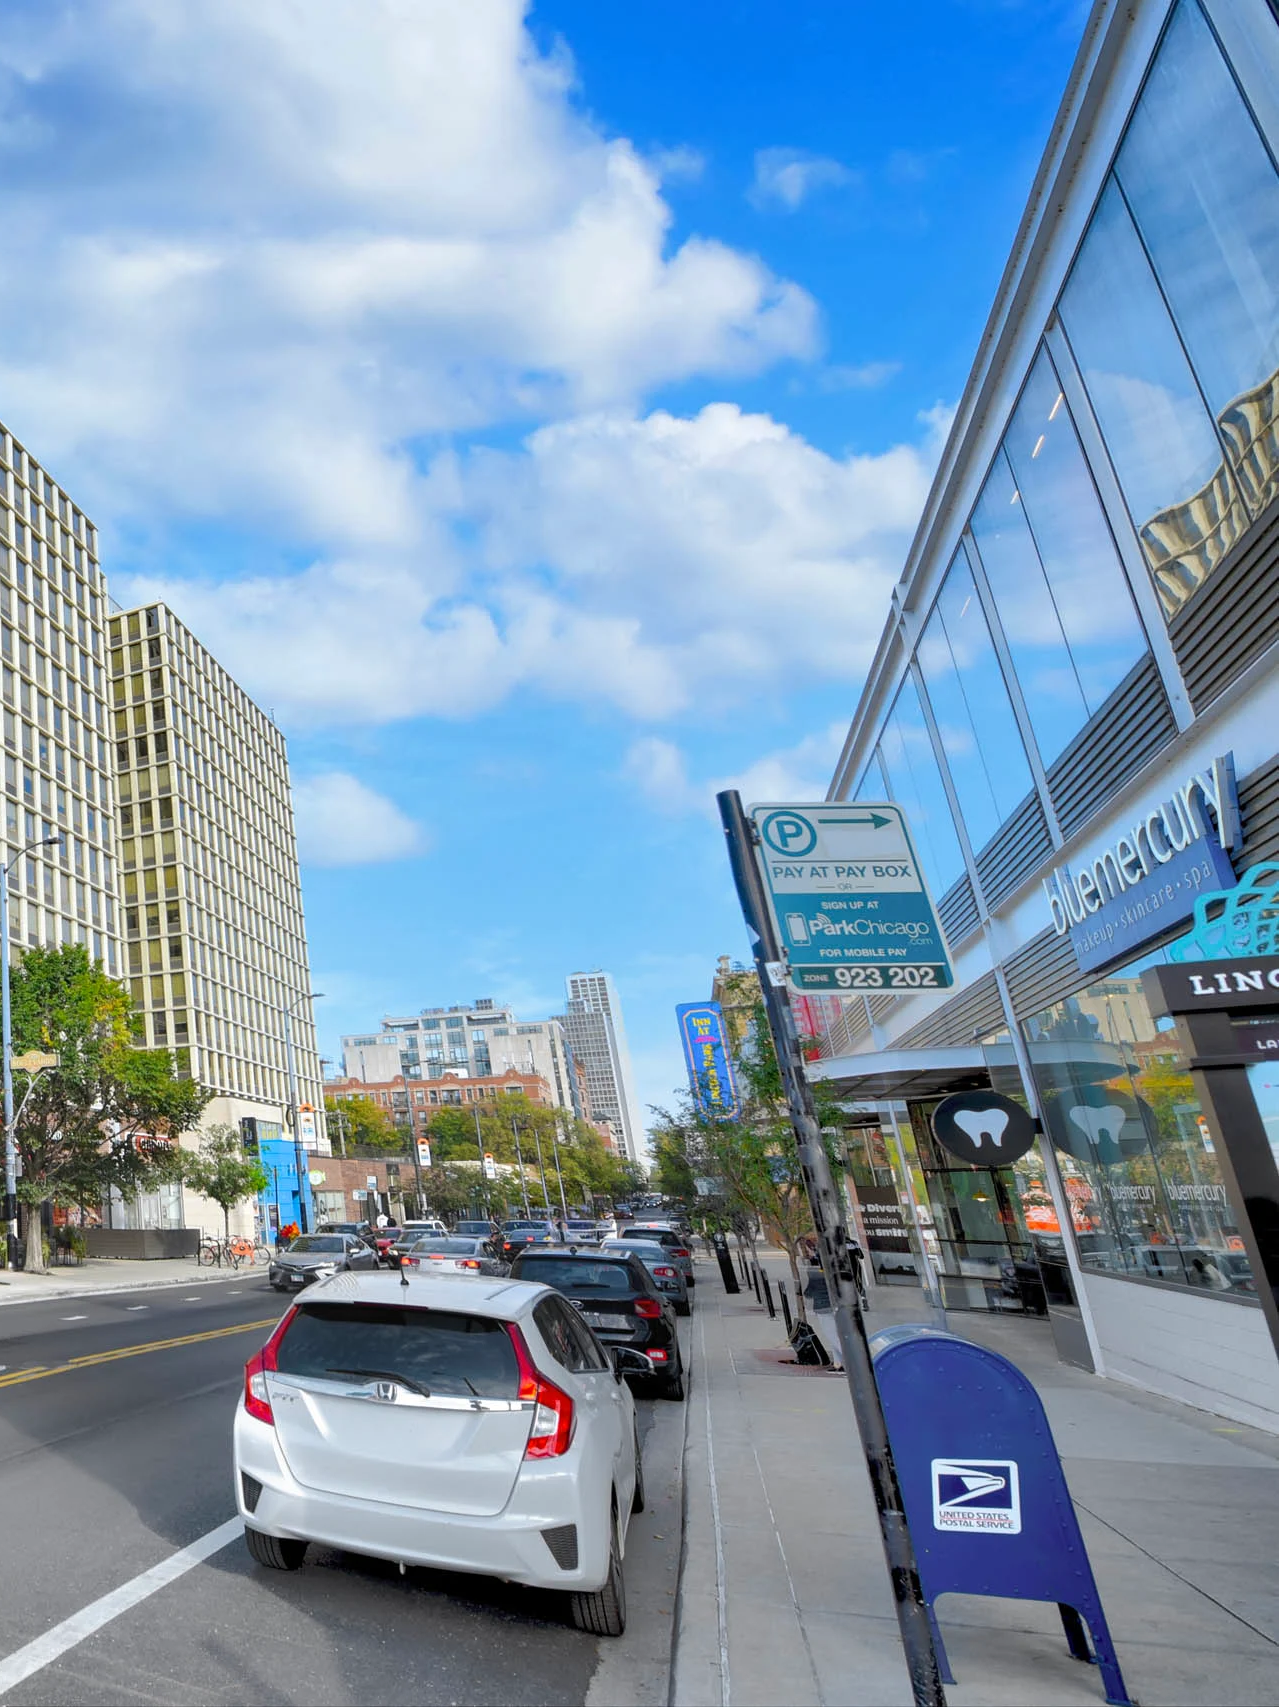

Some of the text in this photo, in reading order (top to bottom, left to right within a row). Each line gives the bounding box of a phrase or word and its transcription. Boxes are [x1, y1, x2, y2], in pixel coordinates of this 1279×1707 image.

[775, 820, 803, 848] P
[1042, 752, 1242, 936] bluemercury
[773, 864, 912, 879] PAY AT PAY BOX
[822, 901, 879, 910] SIGN UP AT
[1075, 860, 1212, 957] makeup skincare spa
[809, 919, 930, 938] ParkChicago
[820, 949, 907, 957] FOR MOBILE PAY
[803, 966, 938, 988] ZONE 923 202
[1255, 1039, 1279, 1050] LA
[1165, 1177, 1227, 1207] bluemercury
[869, 1215, 899, 1225] mission
[939, 1510, 1009, 1520] UNITED STATES
[977, 1521, 1013, 1529] SERVICE
